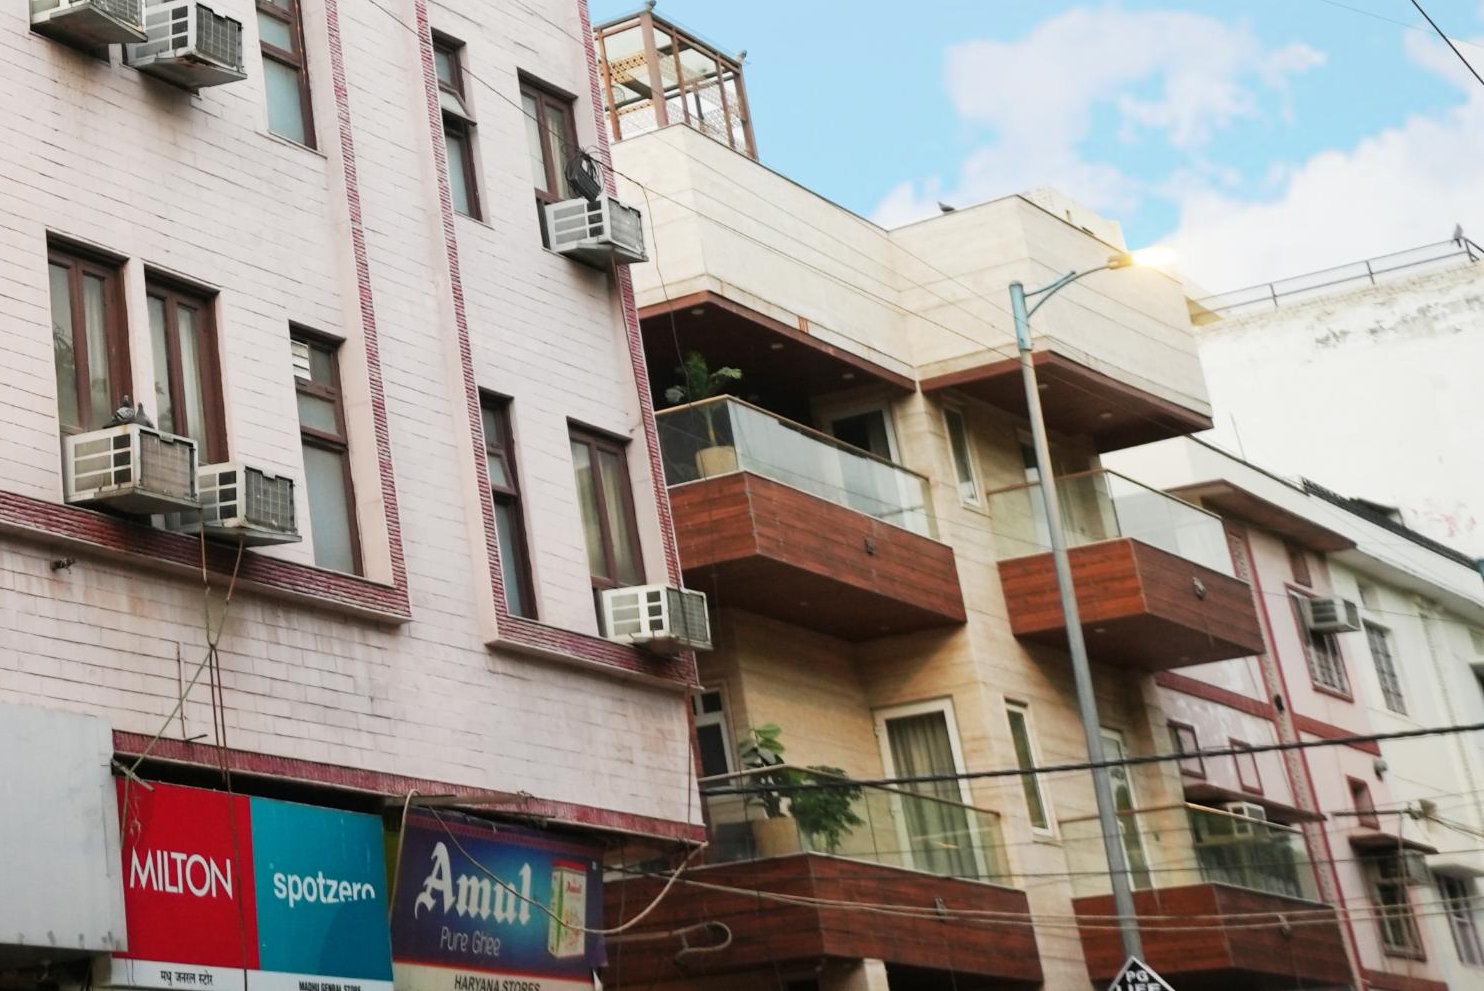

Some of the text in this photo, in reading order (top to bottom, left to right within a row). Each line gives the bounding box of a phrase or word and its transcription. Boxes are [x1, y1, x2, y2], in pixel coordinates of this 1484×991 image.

[130, 846, 233, 899] MILTON
[273, 871, 376, 908] spotzero
[414, 841, 533, 926] Amul
[440, 926, 501, 957] Pure Ghee
[455, 974, 500, 991] HARYANA
[1126, 970, 1149, 983] PG
